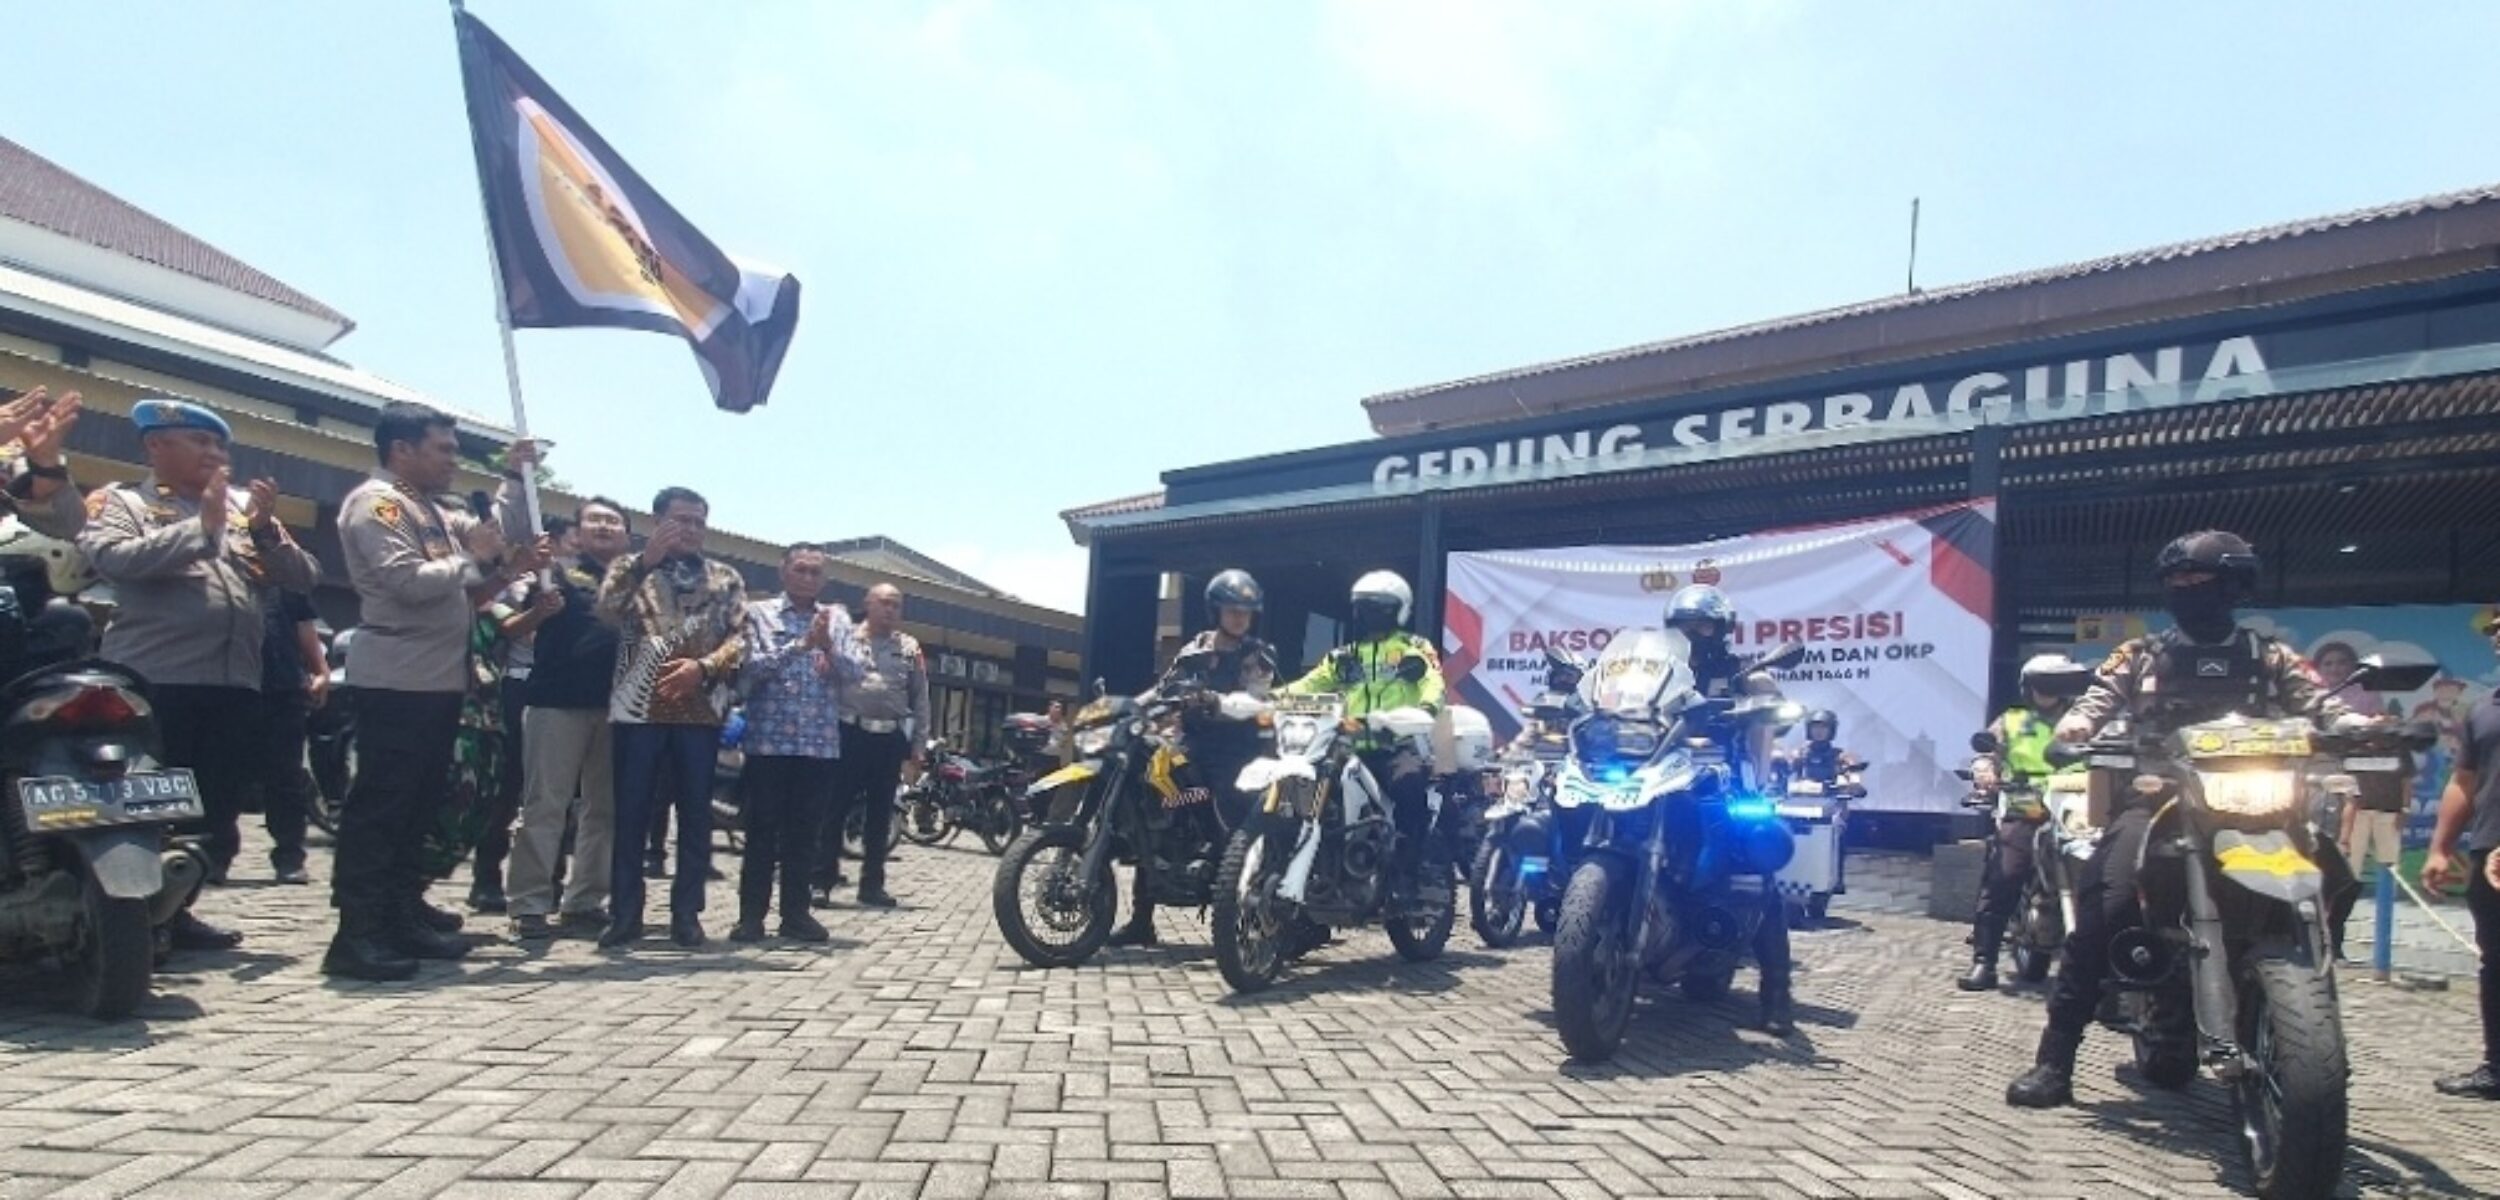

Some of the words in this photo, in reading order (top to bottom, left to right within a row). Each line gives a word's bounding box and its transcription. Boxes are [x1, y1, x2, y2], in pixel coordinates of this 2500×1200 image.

[1373, 424, 1645, 493] GEDUNG
[1509, 627, 1622, 652] BAKSO
[1755, 611, 1904, 645] PRESISI
[1832, 645, 1879, 662] DAN
[1885, 643, 1935, 660] OKP
[1857, 668, 1870, 679] H
